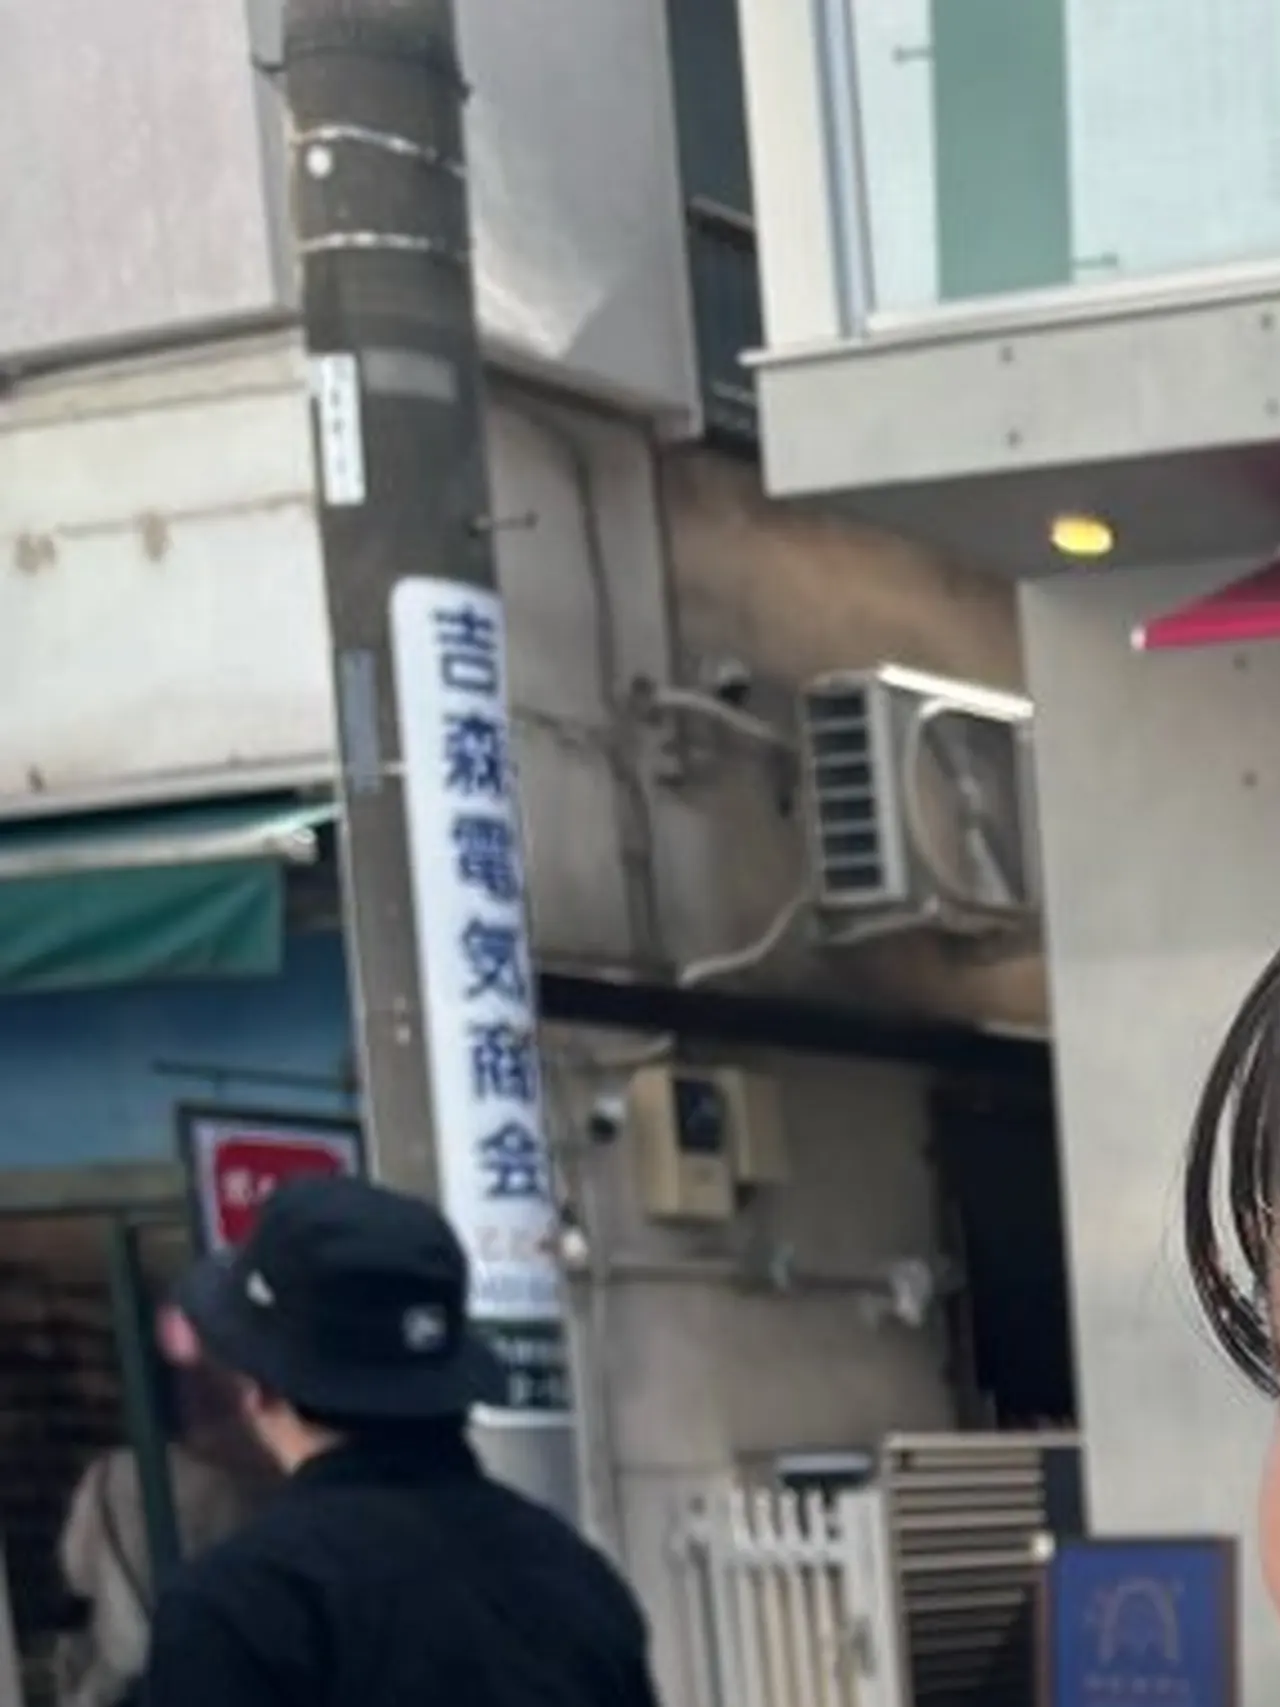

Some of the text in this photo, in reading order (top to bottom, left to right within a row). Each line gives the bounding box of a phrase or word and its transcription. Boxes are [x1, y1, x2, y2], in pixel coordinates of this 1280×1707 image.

[432, 602, 548, 1200] 吉森電気商会
